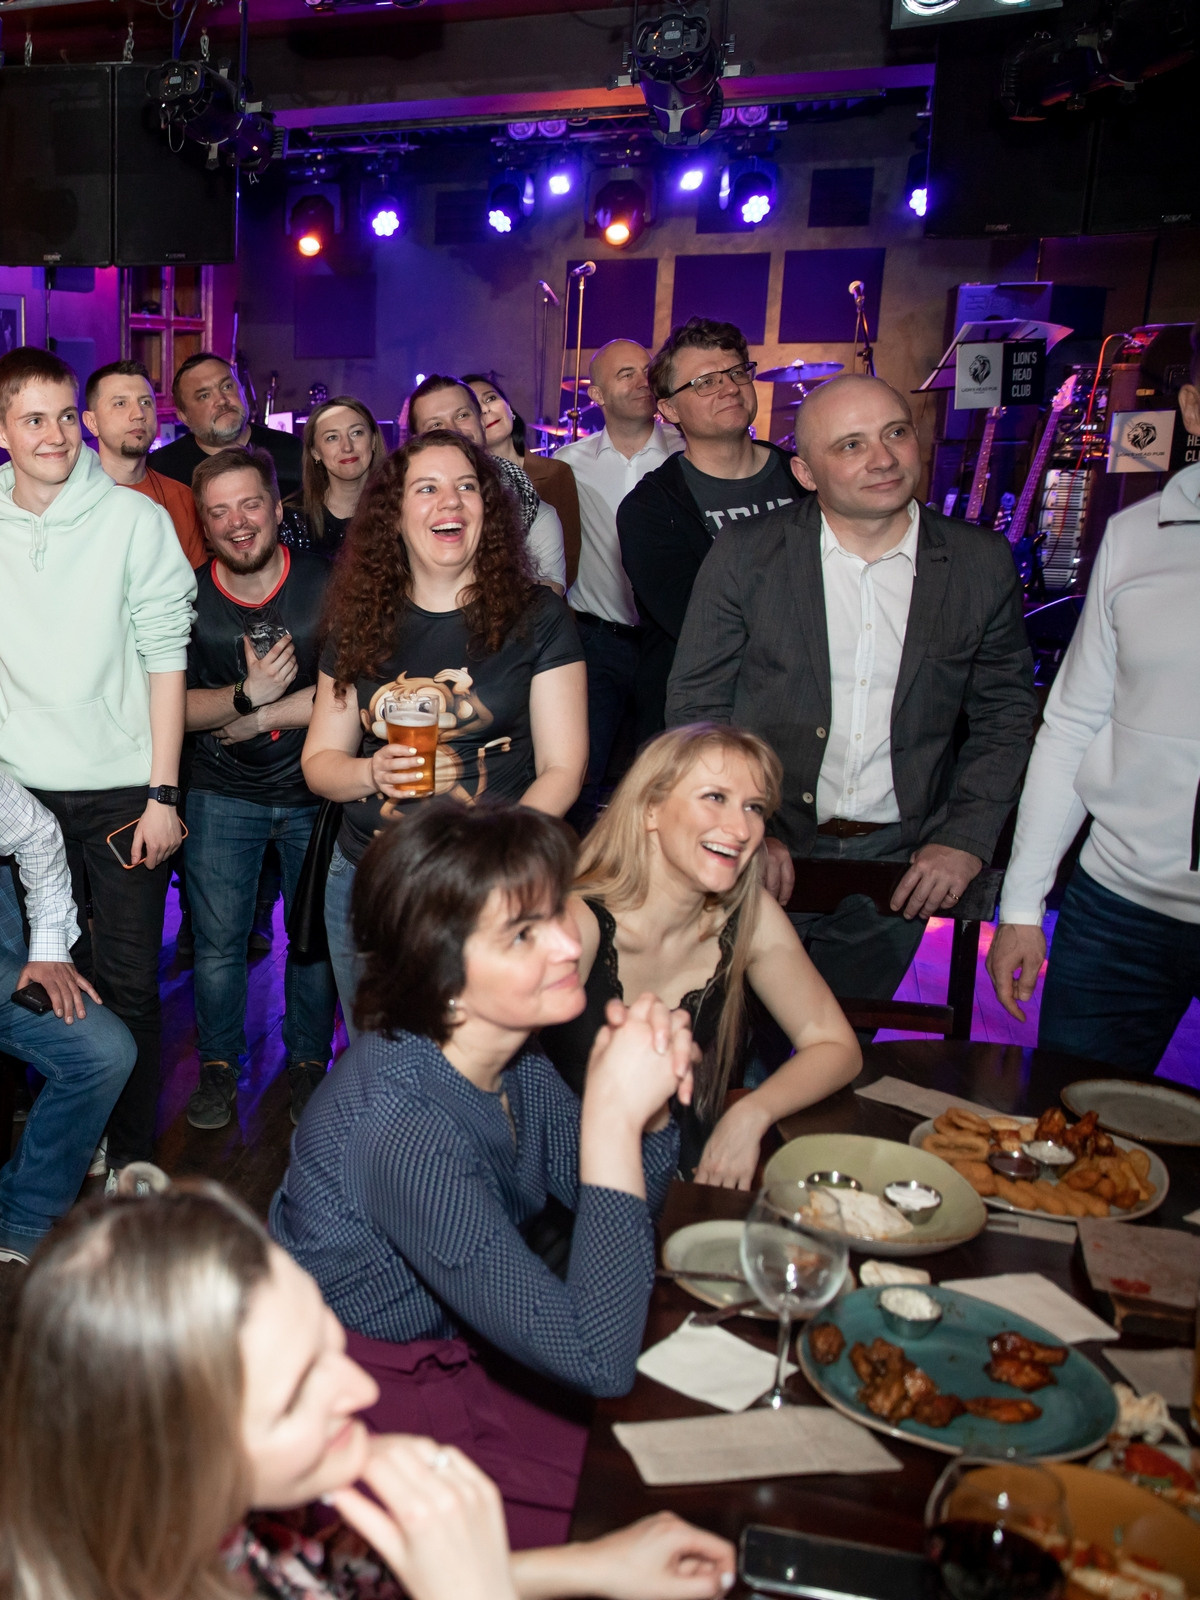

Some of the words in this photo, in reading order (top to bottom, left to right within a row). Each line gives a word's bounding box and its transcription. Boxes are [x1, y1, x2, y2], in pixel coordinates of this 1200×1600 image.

[1013, 351, 1038, 365] LION'S
[1012, 368, 1032, 381] HEAD
[1011, 384, 1032, 397] CLUB
